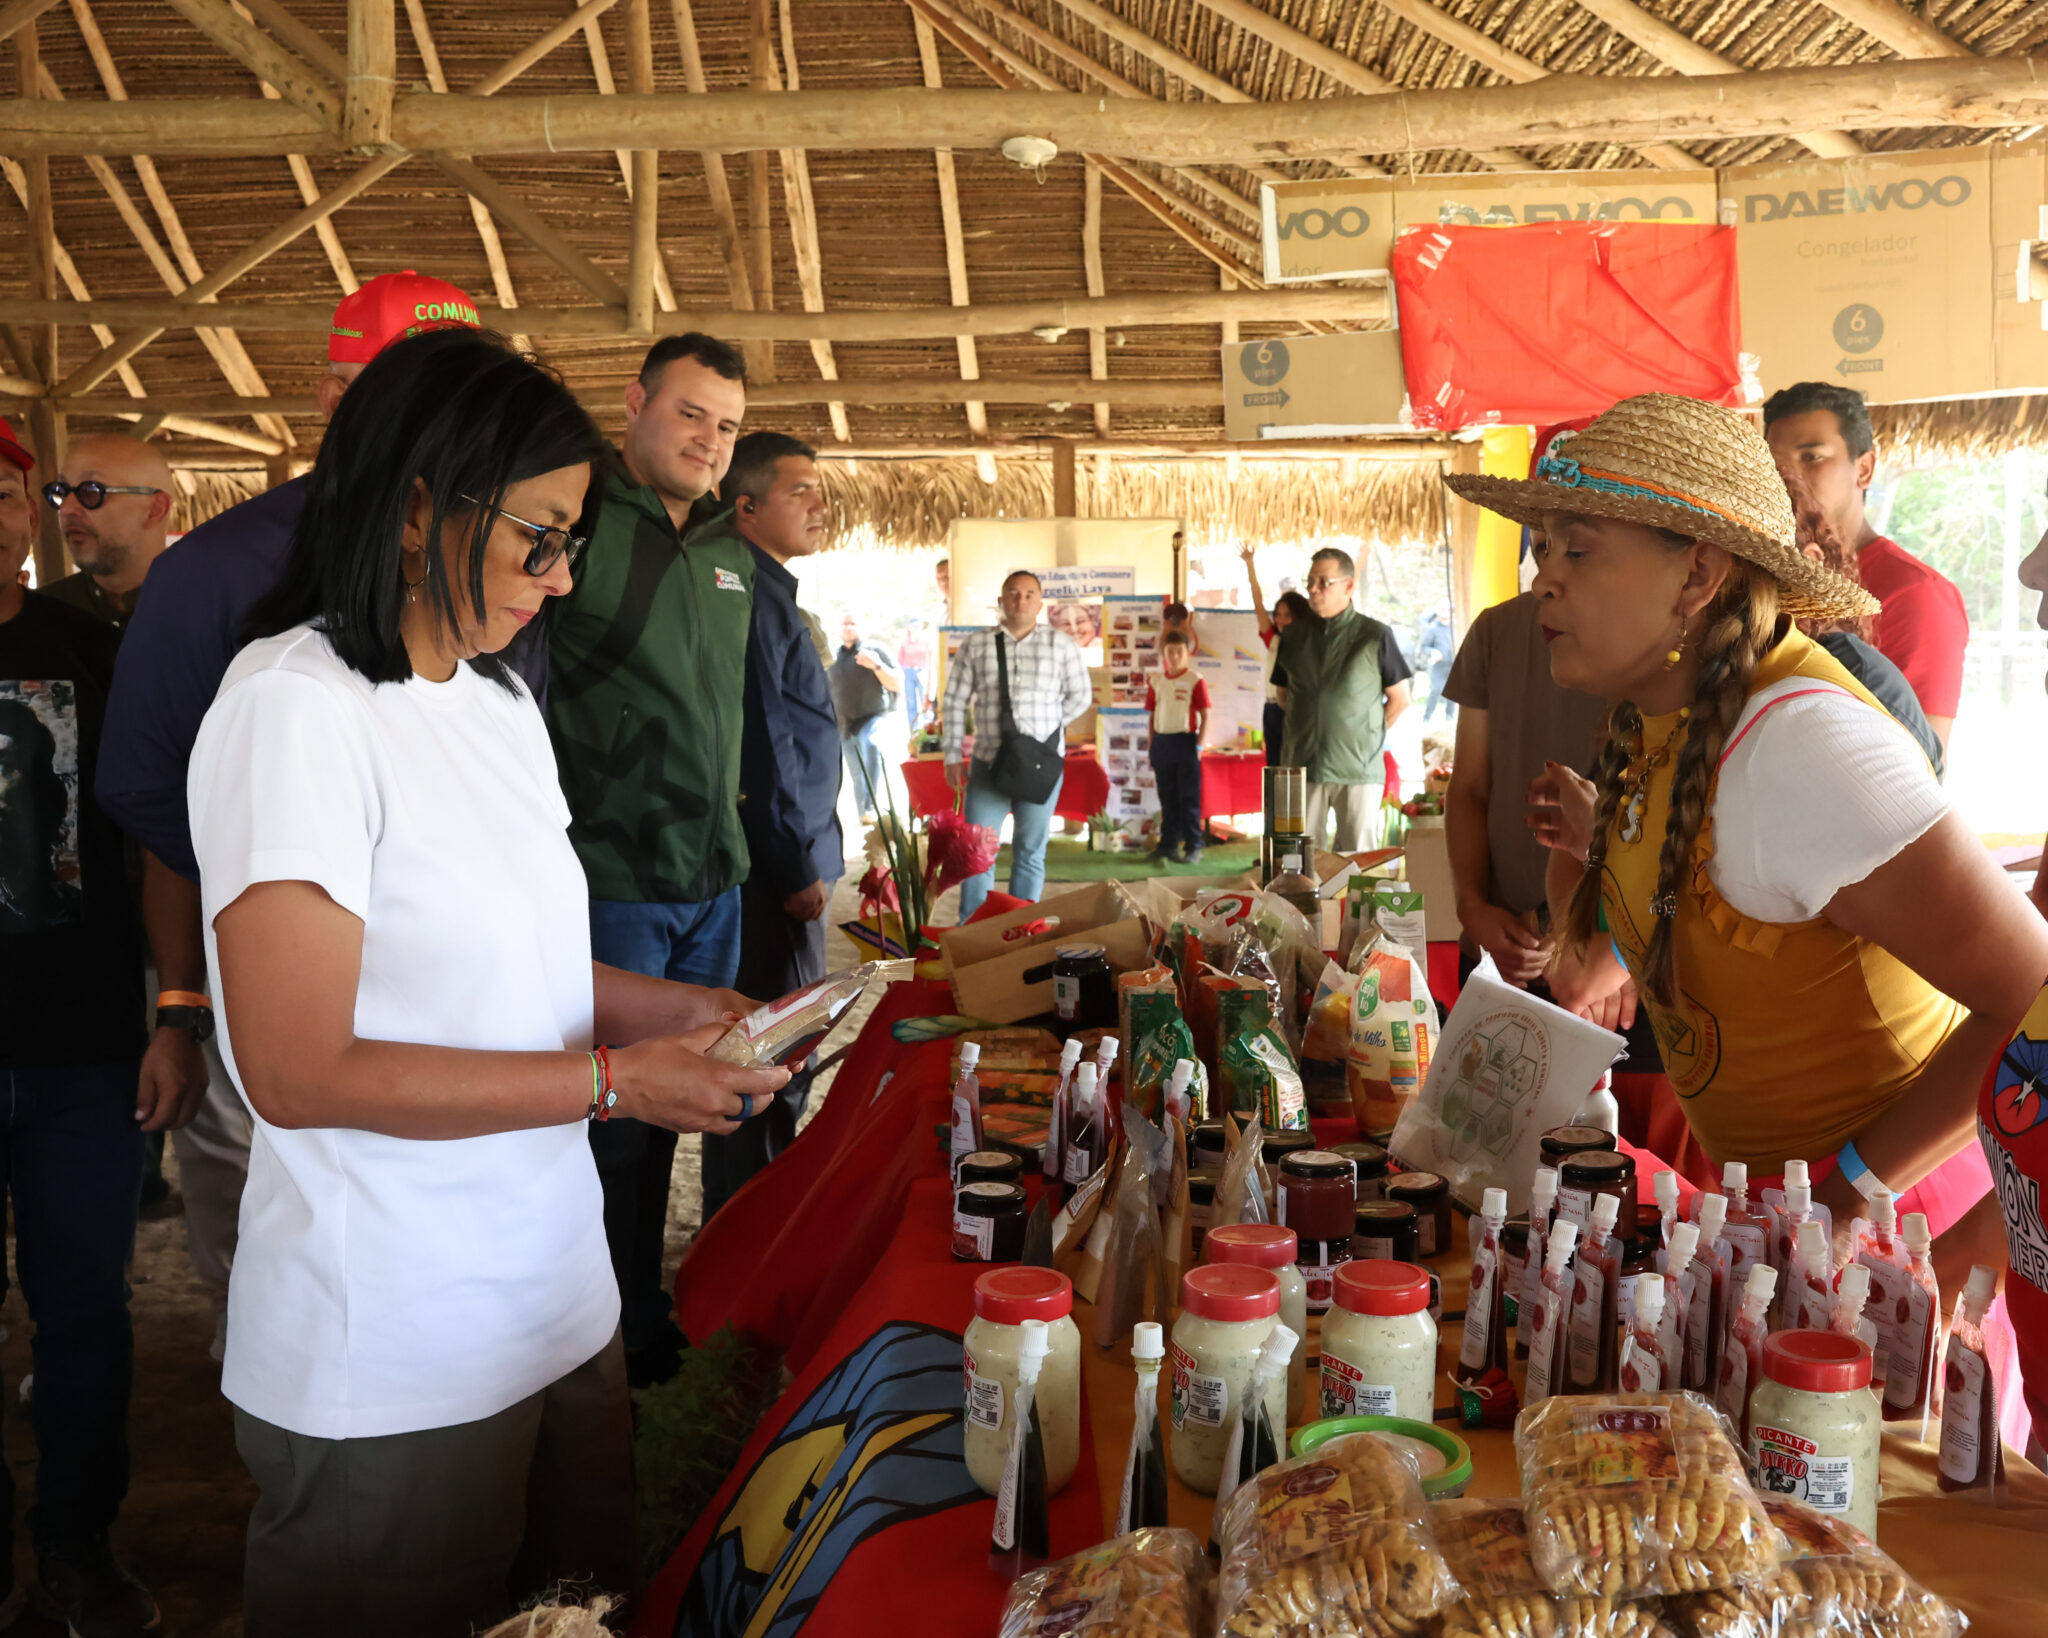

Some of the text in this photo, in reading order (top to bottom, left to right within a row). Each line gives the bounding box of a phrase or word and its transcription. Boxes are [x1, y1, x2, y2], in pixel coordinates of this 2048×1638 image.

[1744, 175, 1972, 223] DAEWOO
[1796, 233, 1919, 259] Congelador
[1850, 308, 1867, 332] 6
[1257, 342, 1273, 364] 6
[1418, 1027, 1428, 1063] Mimoso
[1758, 1428, 1812, 1452] PICANTE
[1760, 1450, 1807, 1478] BURRO
